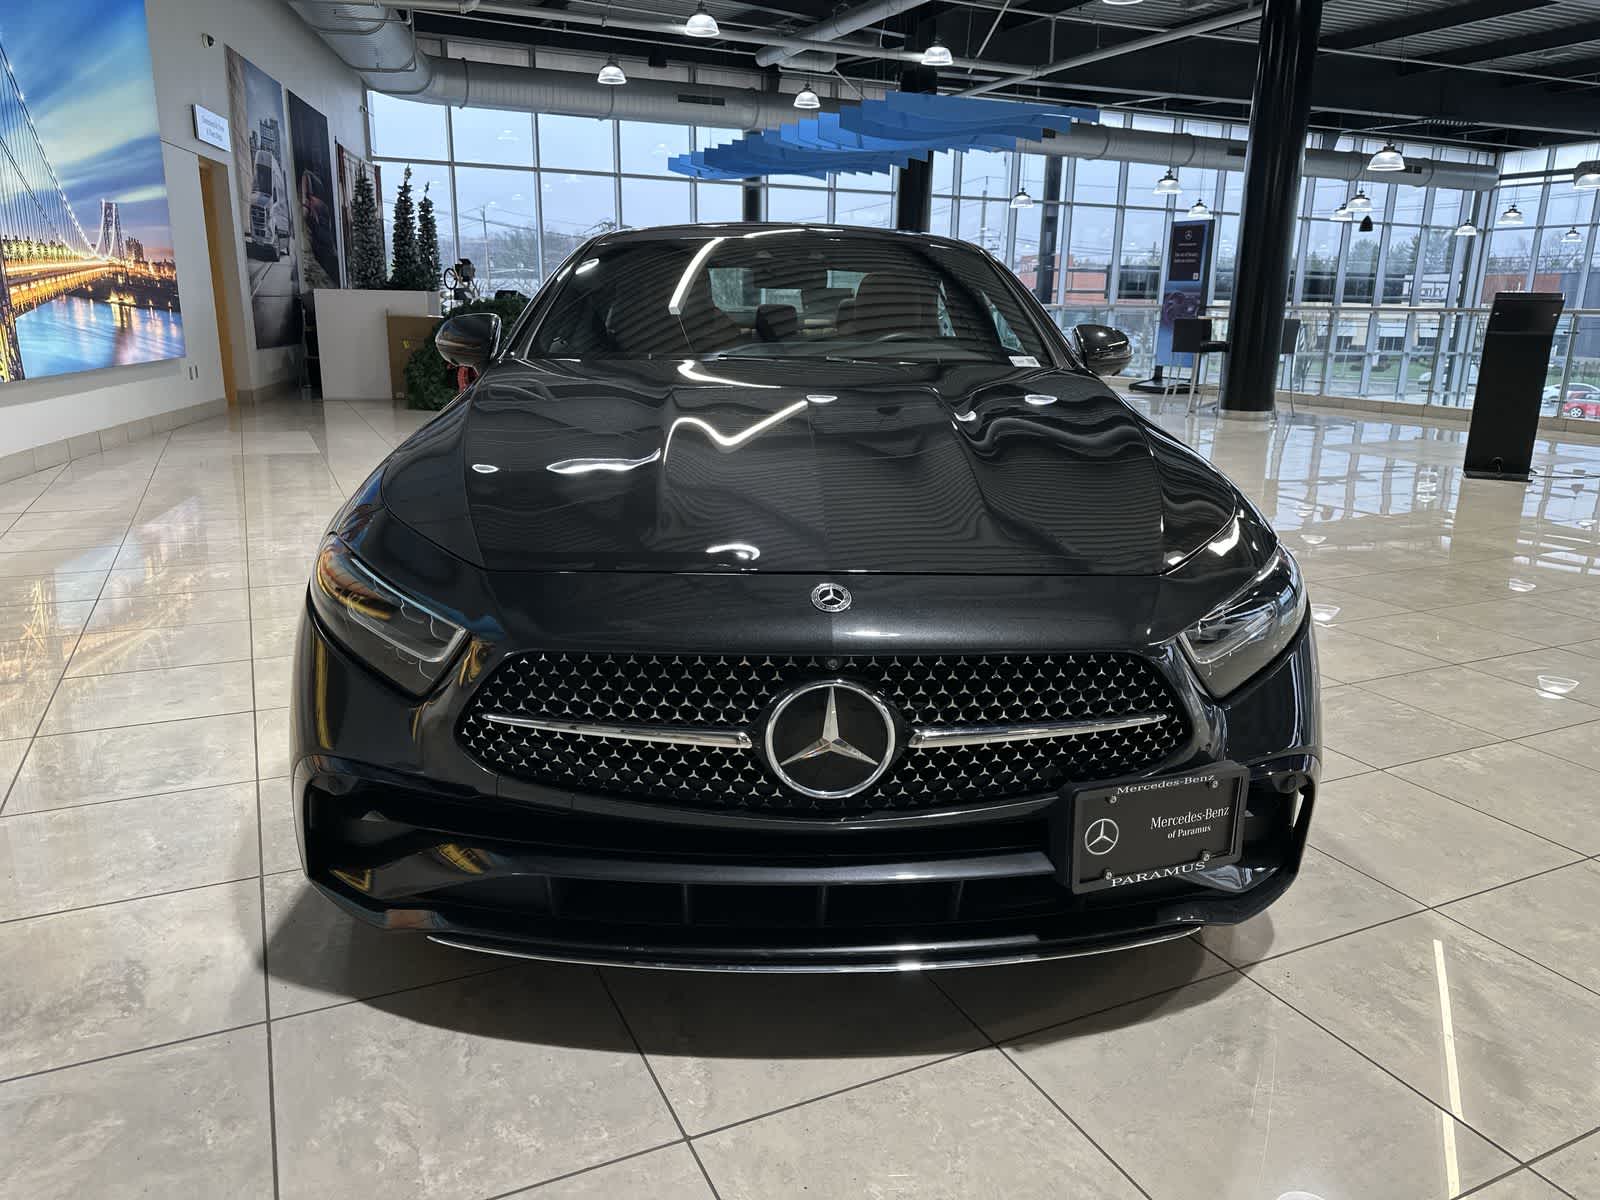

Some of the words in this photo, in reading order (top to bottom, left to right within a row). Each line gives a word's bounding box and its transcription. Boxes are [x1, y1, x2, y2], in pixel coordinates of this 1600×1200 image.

[1116, 774, 1215, 795] Mercedes-Benz
[1150, 806, 1230, 830] Mercedes-Benz
[1167, 830, 1176, 839] of
[1177, 824, 1212, 838] Paramus
[1111, 861, 1206, 887] PARAMUS
